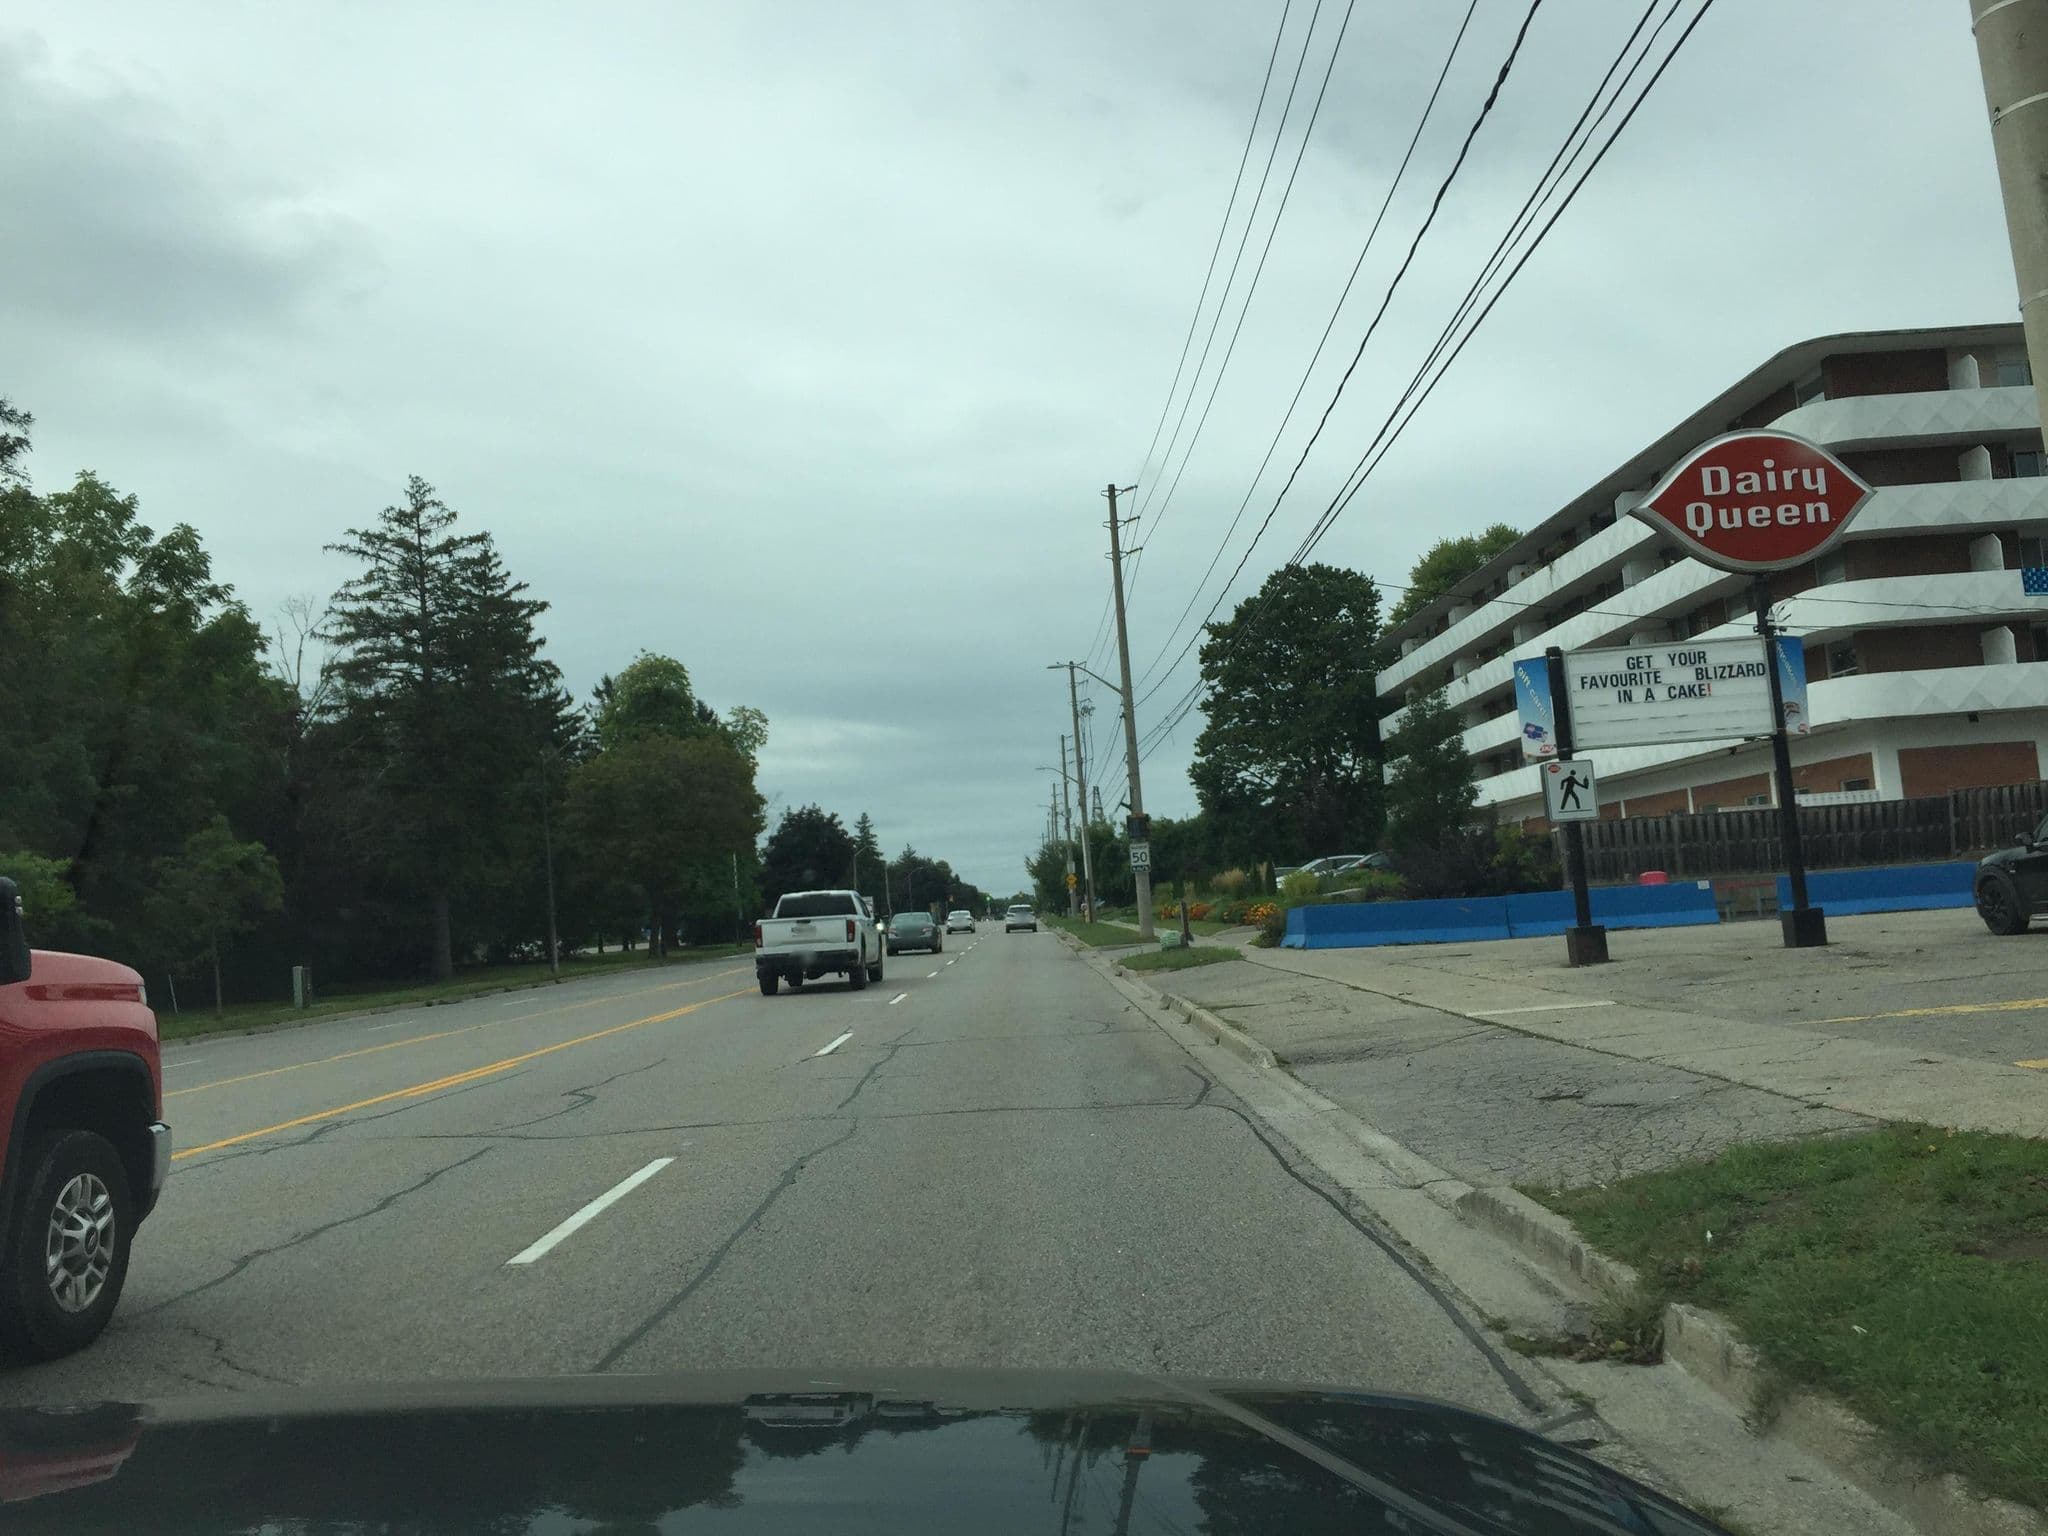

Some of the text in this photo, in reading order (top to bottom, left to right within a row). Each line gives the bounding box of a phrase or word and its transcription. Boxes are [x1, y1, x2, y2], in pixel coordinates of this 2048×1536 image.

[1701, 459, 1827, 496] Dairy
[1685, 501, 1830, 538] Queen
[1626, 651, 1707, 670] GET YOUR
[1580, 662, 1766, 690] FAVOURITE BLIZZARD
[1618, 683, 1712, 703] IN A CAKE!
[1132, 851, 1148, 863] 50
